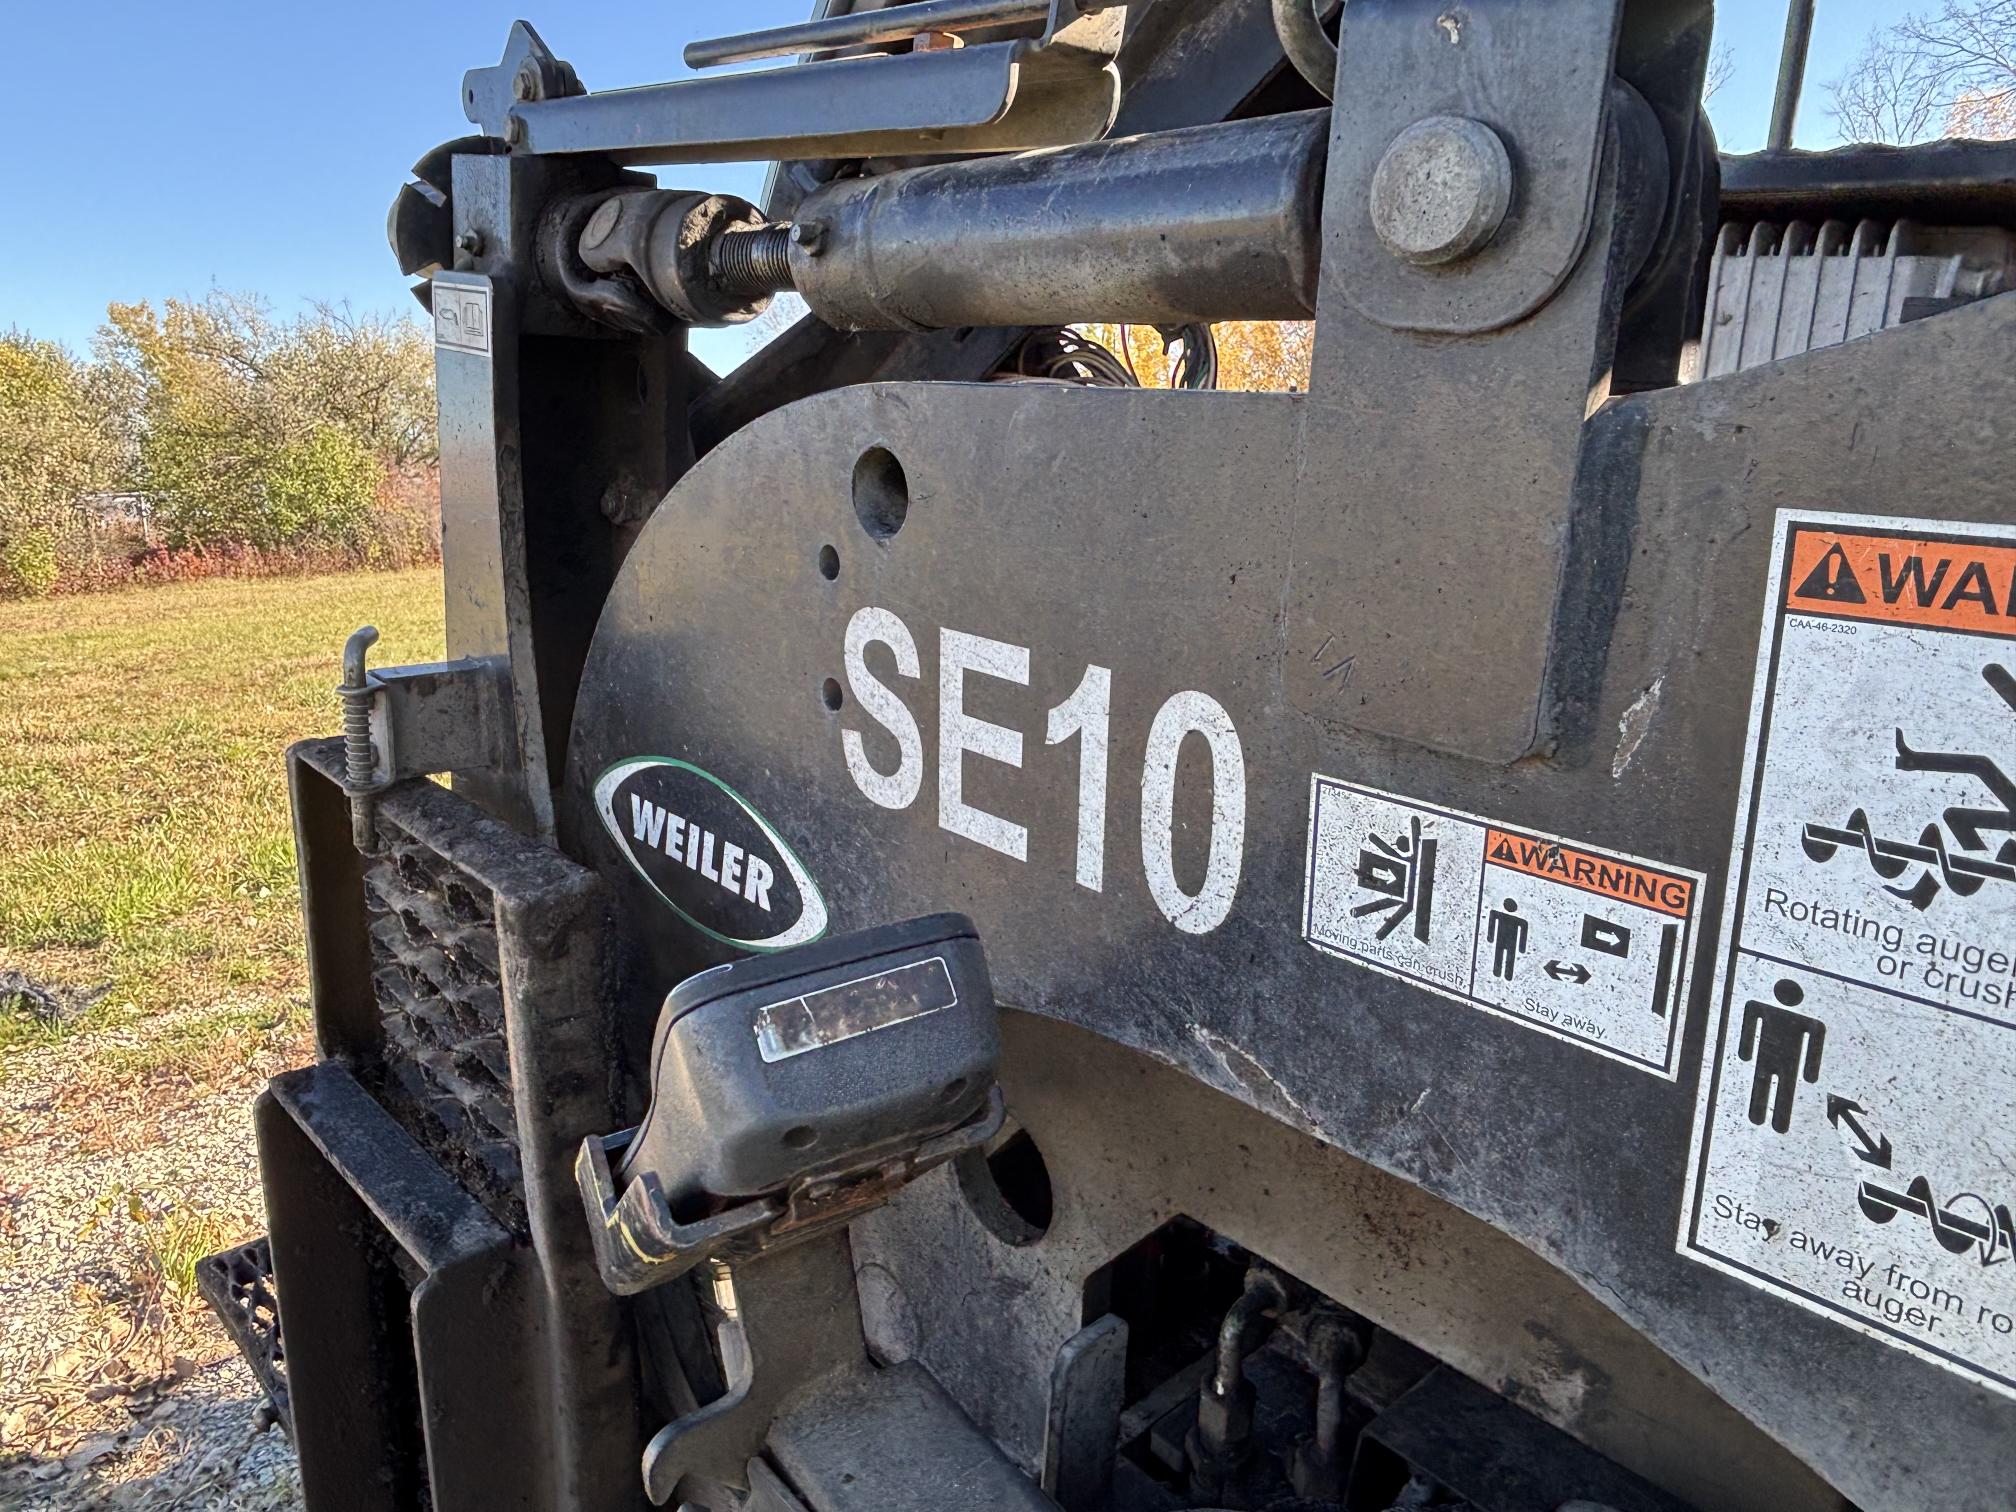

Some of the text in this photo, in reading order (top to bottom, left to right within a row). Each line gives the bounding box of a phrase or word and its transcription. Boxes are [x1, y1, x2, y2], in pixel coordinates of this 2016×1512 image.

[1878, 552, 2016, 618] WA
[1788, 617, 1857, 635] CAA-46-2320
[841, 606, 1246, 934] SE10
[631, 792, 774, 912] WEILER
[1519, 841, 1686, 909] WARNING
[1313, 923, 1358, 949] Moving
[1360, 940, 1393, 961] parts
[1398, 954, 1421, 971] can
[1764, 887, 1904, 952] Rotating
[1877, 955, 1914, 979] or
[1524, 997, 1559, 1022] Stay
[1711, 1194, 1779, 1241] Stay
[1789, 1230, 1875, 1280] away
[1885, 1263, 1964, 1315] from
